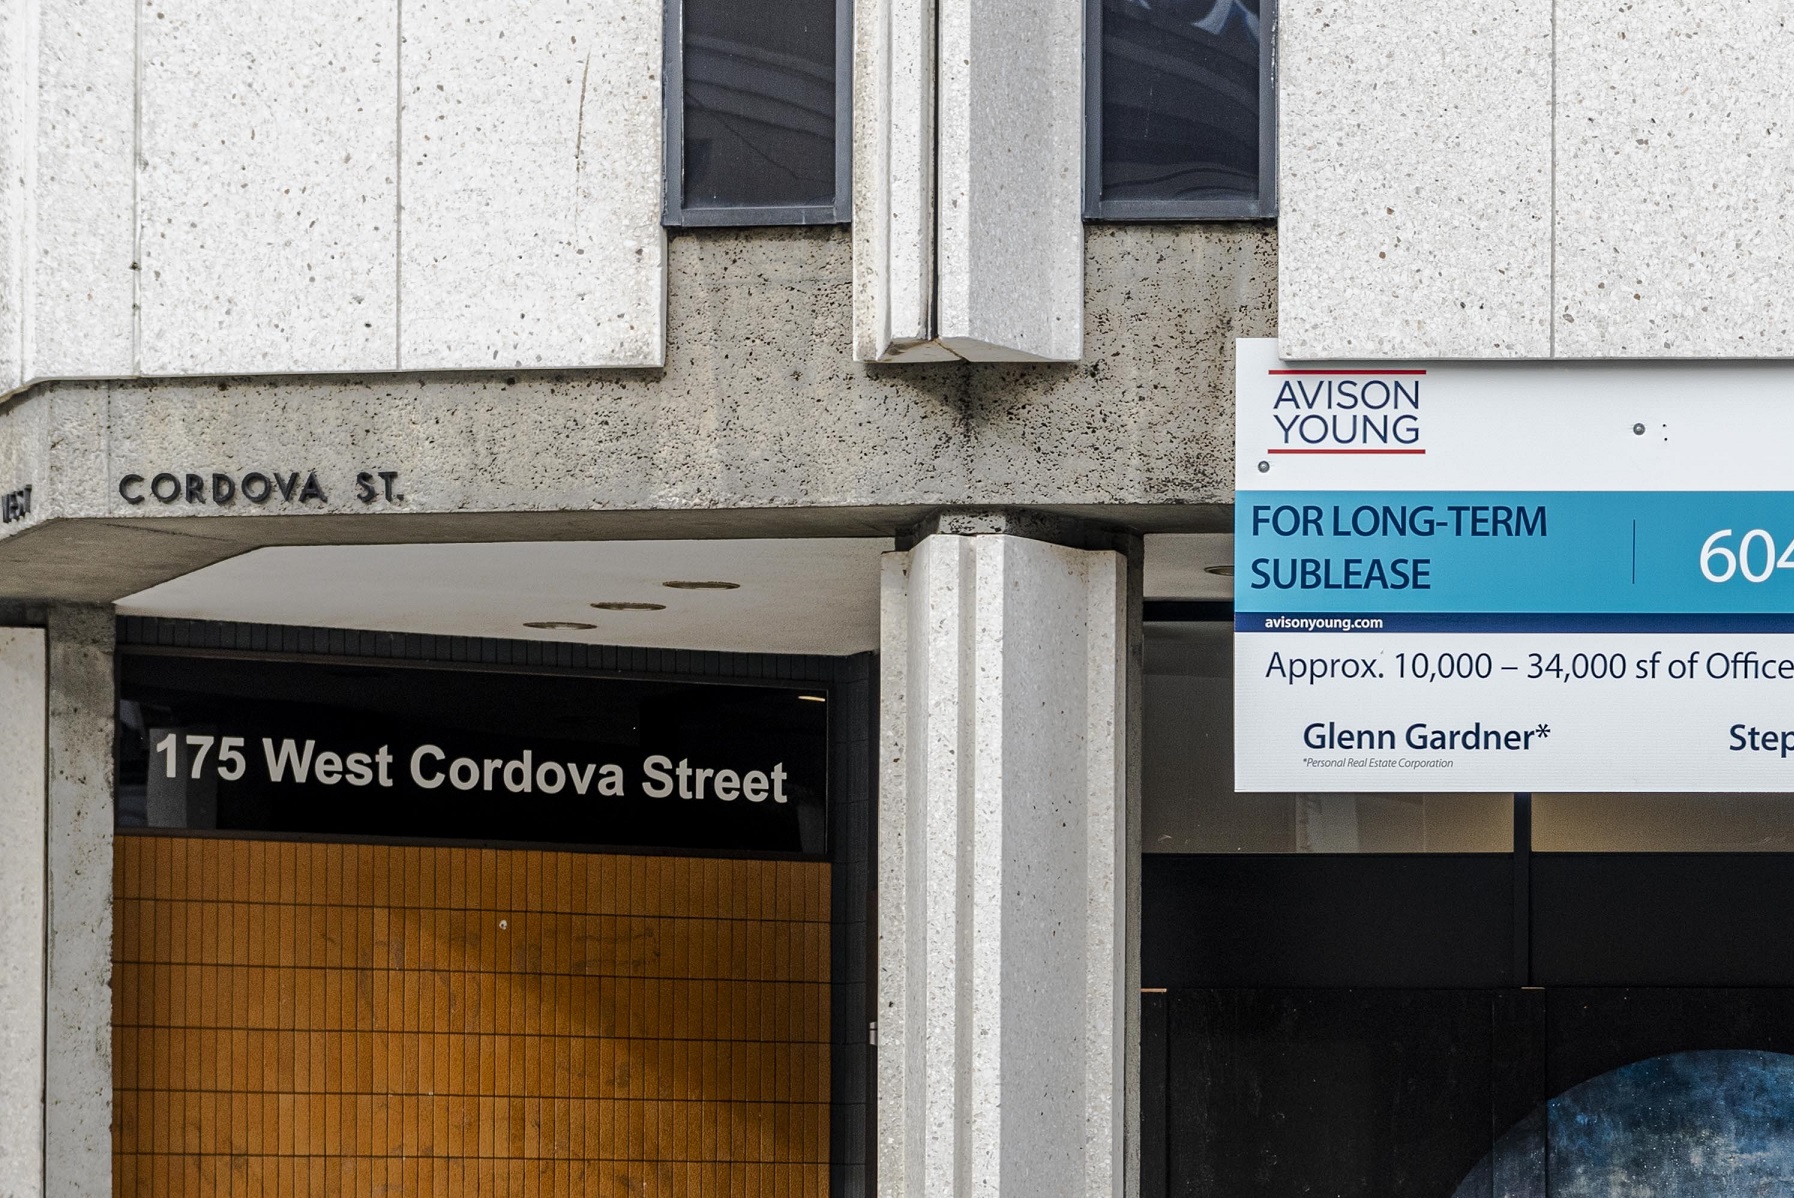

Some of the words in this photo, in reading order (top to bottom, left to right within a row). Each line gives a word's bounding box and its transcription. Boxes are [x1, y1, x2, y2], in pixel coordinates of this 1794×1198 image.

[1273, 380, 1419, 409] AVISON
[1273, 414, 1419, 444] YOUNG
[119, 472, 327, 504] CORDOVA
[356, 472, 404, 502] ST.
[1253, 505, 1324, 537] FOR
[1333, 505, 1547, 537] LONG-TERM
[1251, 558, 1431, 590] SUBLEASE
[1265, 617, 1383, 631] avisonyoung.com
[1266, 651, 1383, 684] Approx.
[1396, 653, 1491, 682] 10,000
[1527, 653, 1626, 682] 34,000
[1635, 651, 1661, 679] sf
[1668, 651, 1699, 679] of
[1706, 652, 1794, 679] Office
[1303, 722, 1395, 750] Glenn
[155, 733, 246, 780] 175
[262, 739, 393, 788] West
[410, 745, 625, 796] Cordova
[642, 755, 788, 803] Street
[1348, 758, 1367, 768] Real
[1369, 758, 1396, 768] Estate
[1399, 758, 1453, 769] Corporation
